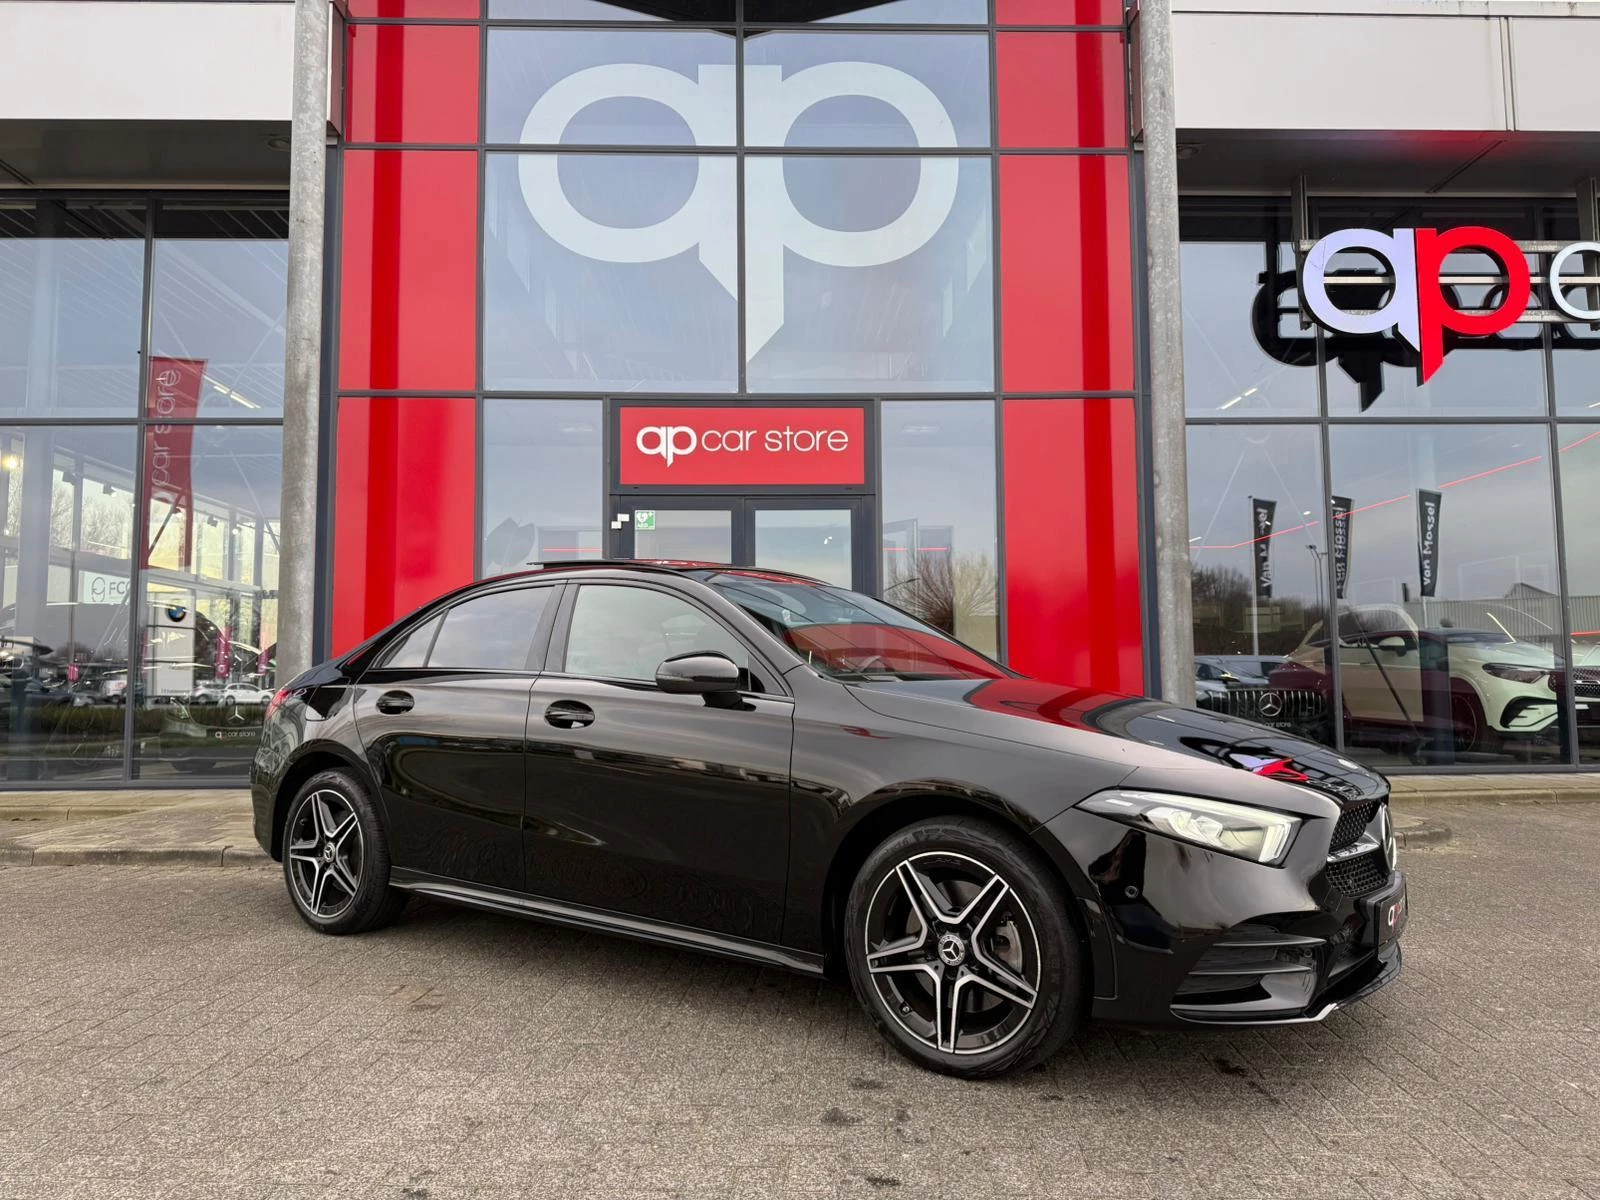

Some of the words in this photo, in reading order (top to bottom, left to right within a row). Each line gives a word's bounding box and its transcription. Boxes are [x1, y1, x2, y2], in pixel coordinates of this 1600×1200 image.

[518, 61, 959, 364] ap
[1302, 226, 1531, 384] ap
[151, 440, 171, 487] car
[636, 426, 698, 468] ap
[701, 430, 757, 452] car
[764, 426, 849, 452] store
[1423, 501, 1435, 555] Mossel
